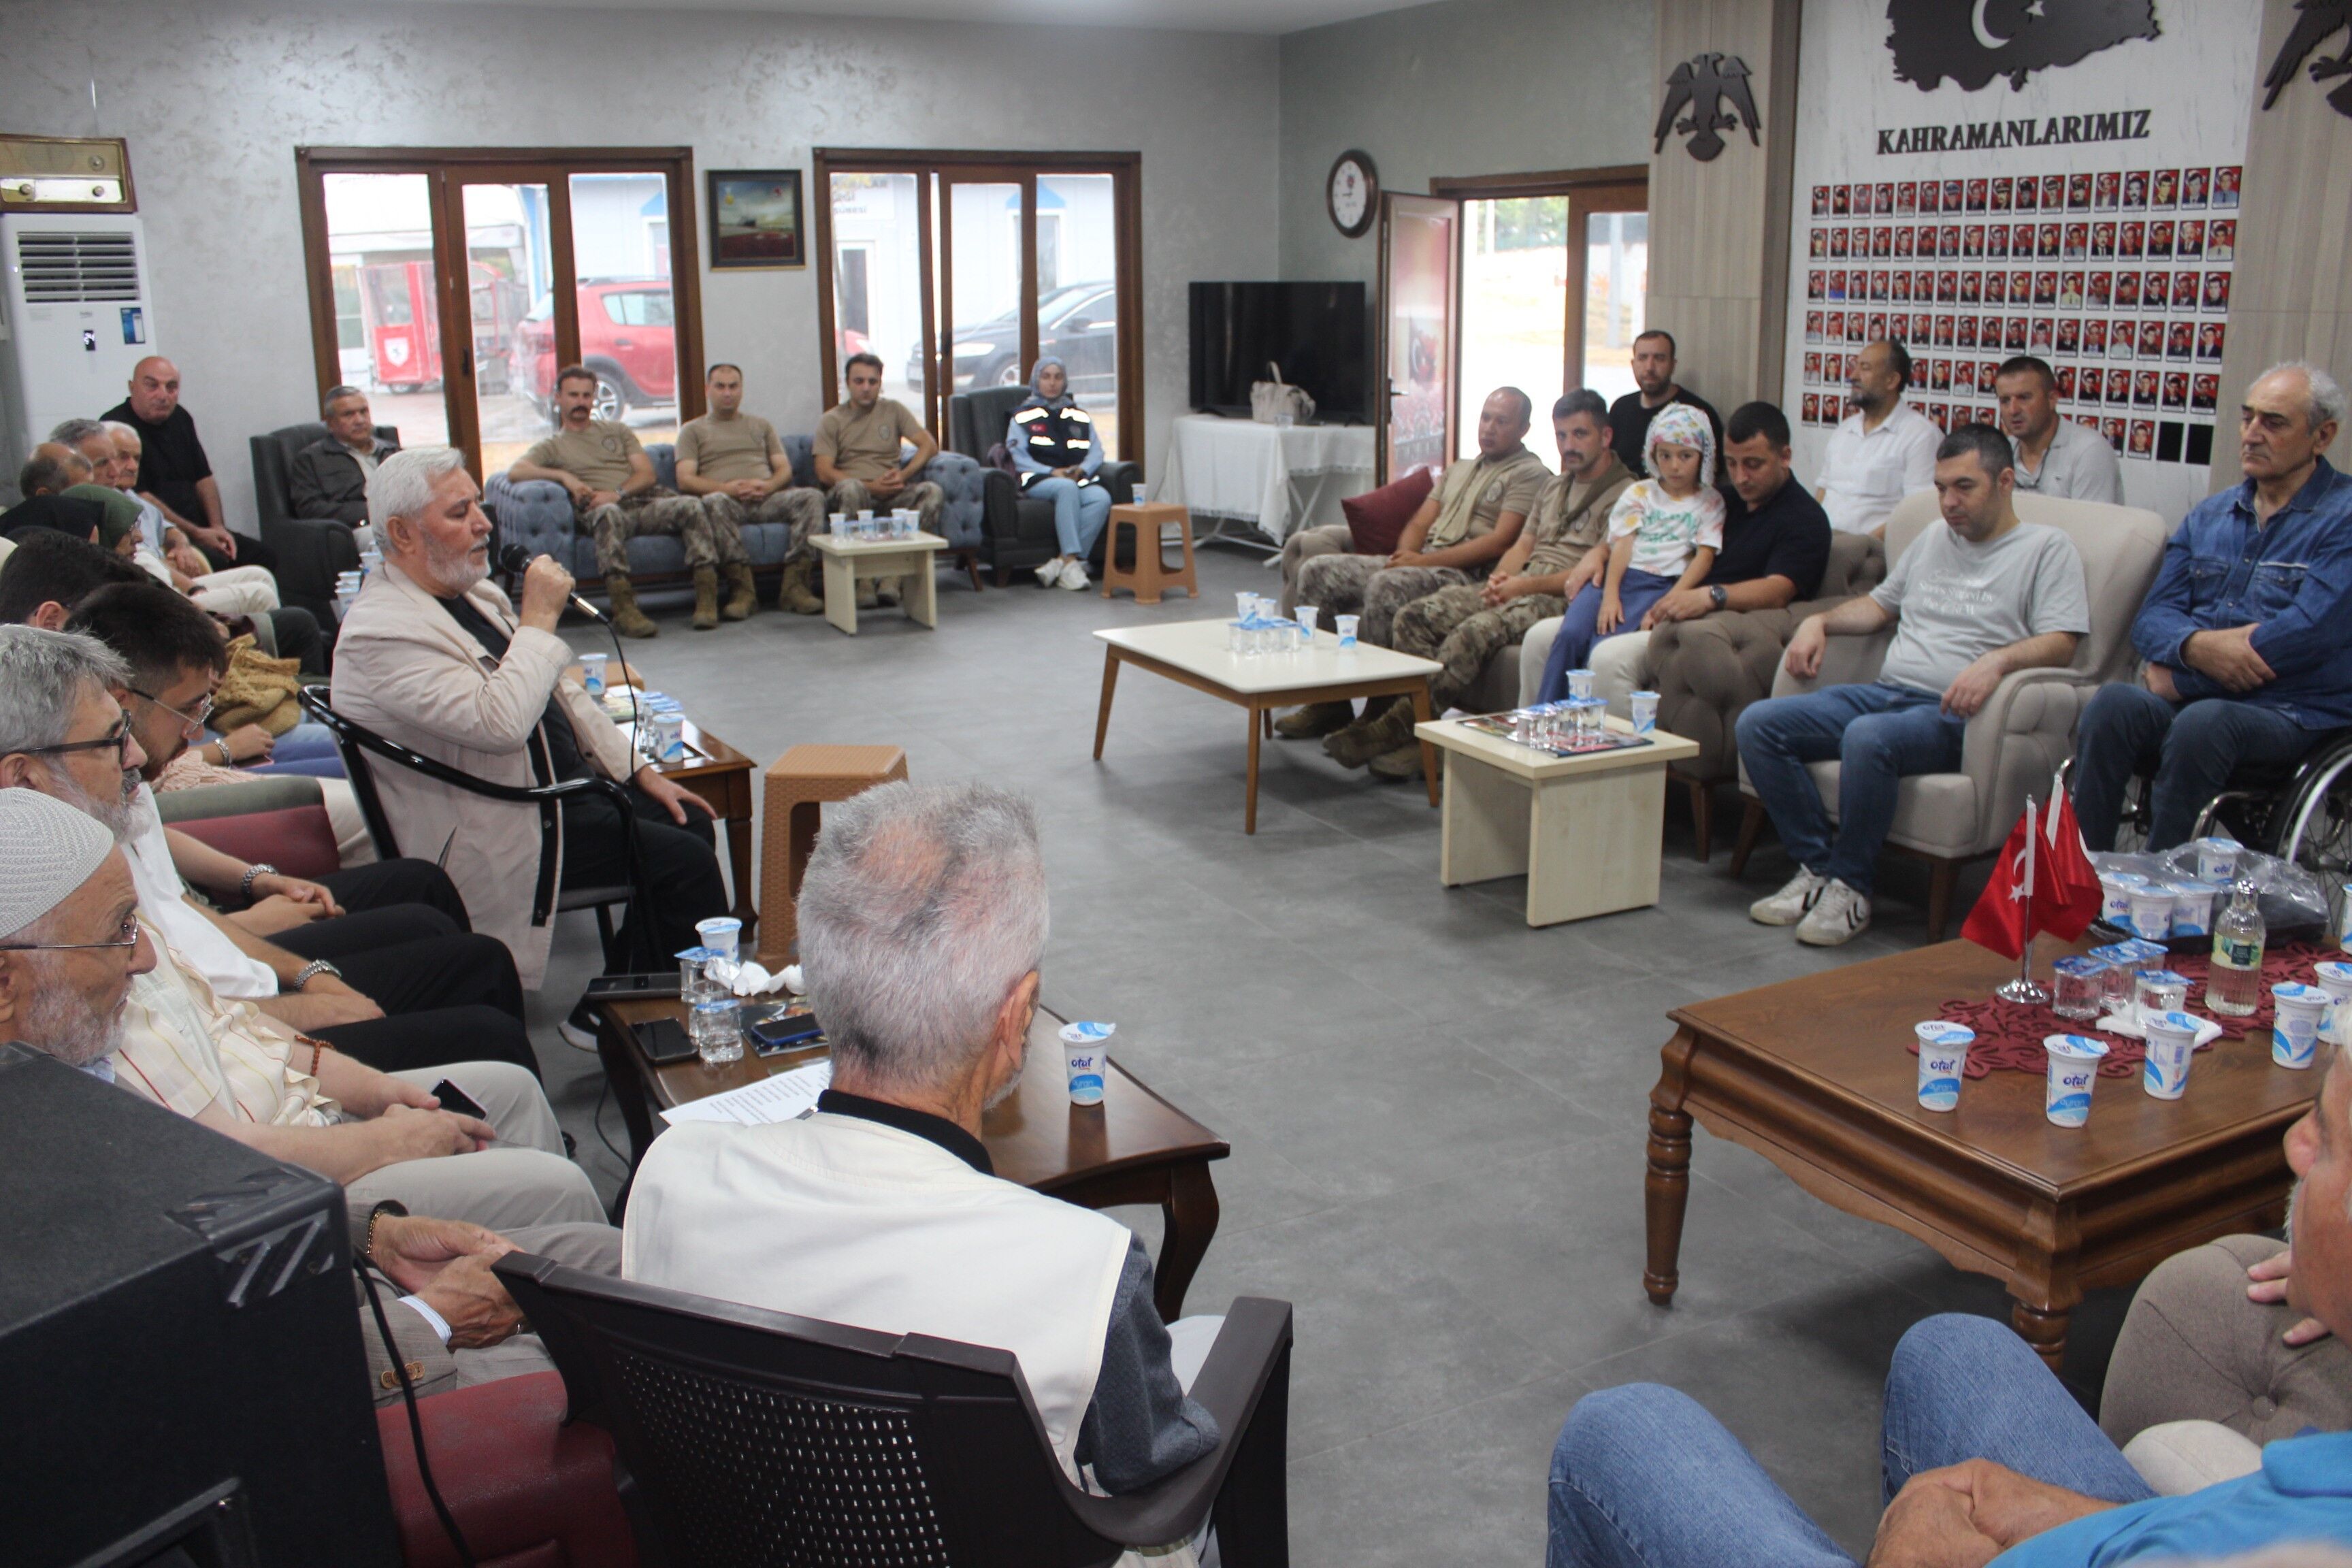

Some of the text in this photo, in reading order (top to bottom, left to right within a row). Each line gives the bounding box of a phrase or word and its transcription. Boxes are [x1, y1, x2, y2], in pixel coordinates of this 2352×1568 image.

[1877, 110, 2151, 154] KAHRAMANLARIMIZ
[1071, 1056, 1093, 1068] otat
[1930, 1059, 1956, 1071] otat
[2063, 1074, 2089, 1087] otat
